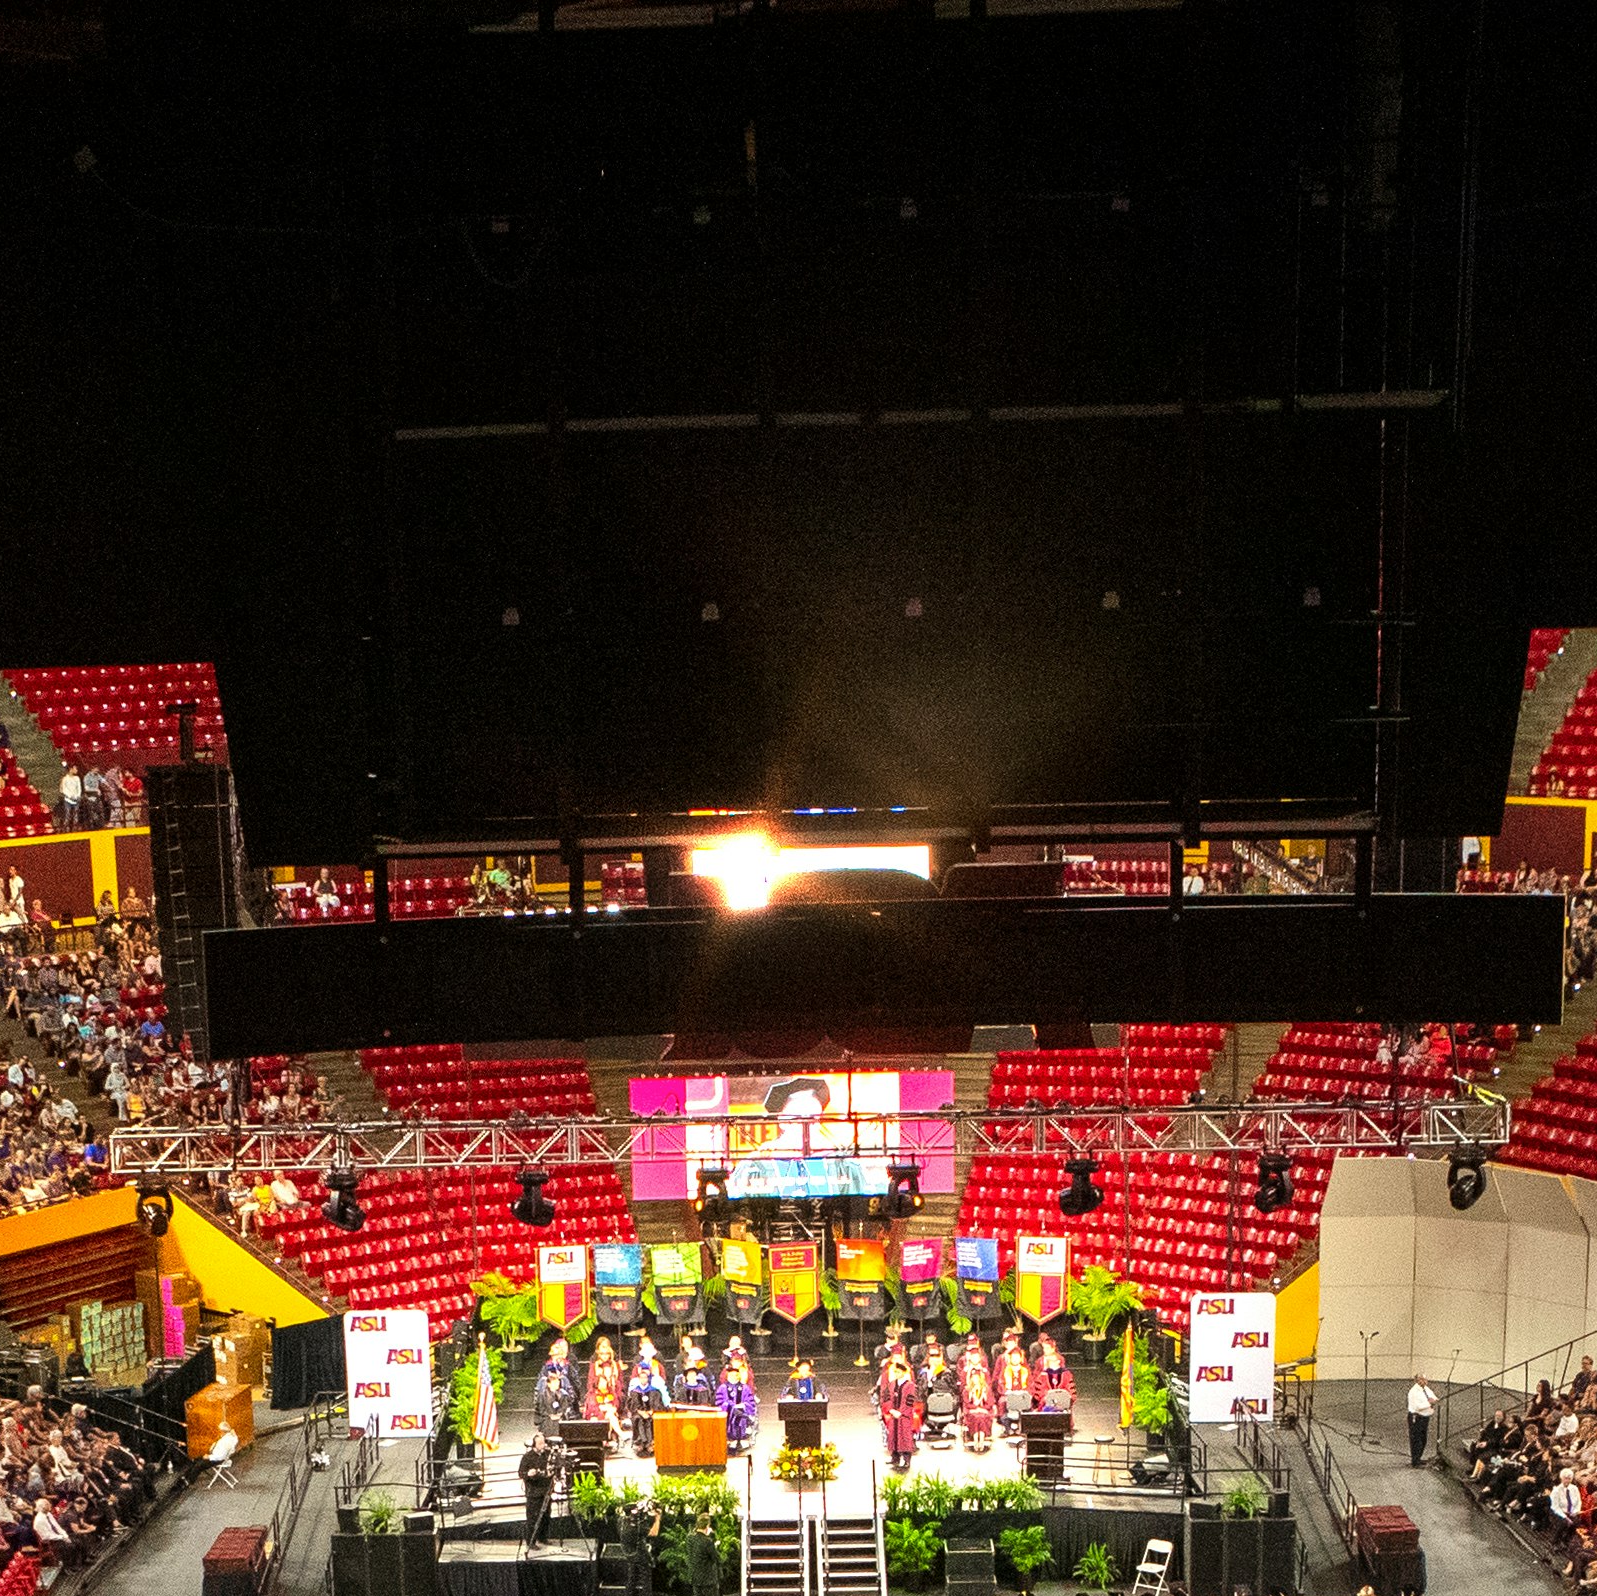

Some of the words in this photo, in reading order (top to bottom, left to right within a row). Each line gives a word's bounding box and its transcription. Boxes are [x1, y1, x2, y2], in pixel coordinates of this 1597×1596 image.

[1026, 1243, 1053, 1255] ASU
[547, 1251, 573, 1265] ASU
[1197, 1299, 1234, 1315] ASU
[350, 1316, 387, 1332] ASU
[1231, 1332, 1269, 1348] ASU
[386, 1349, 423, 1364] ASU
[1196, 1366, 1233, 1382] ASU
[354, 1382, 391, 1398] ASU
[391, 1415, 427, 1430] ASU
